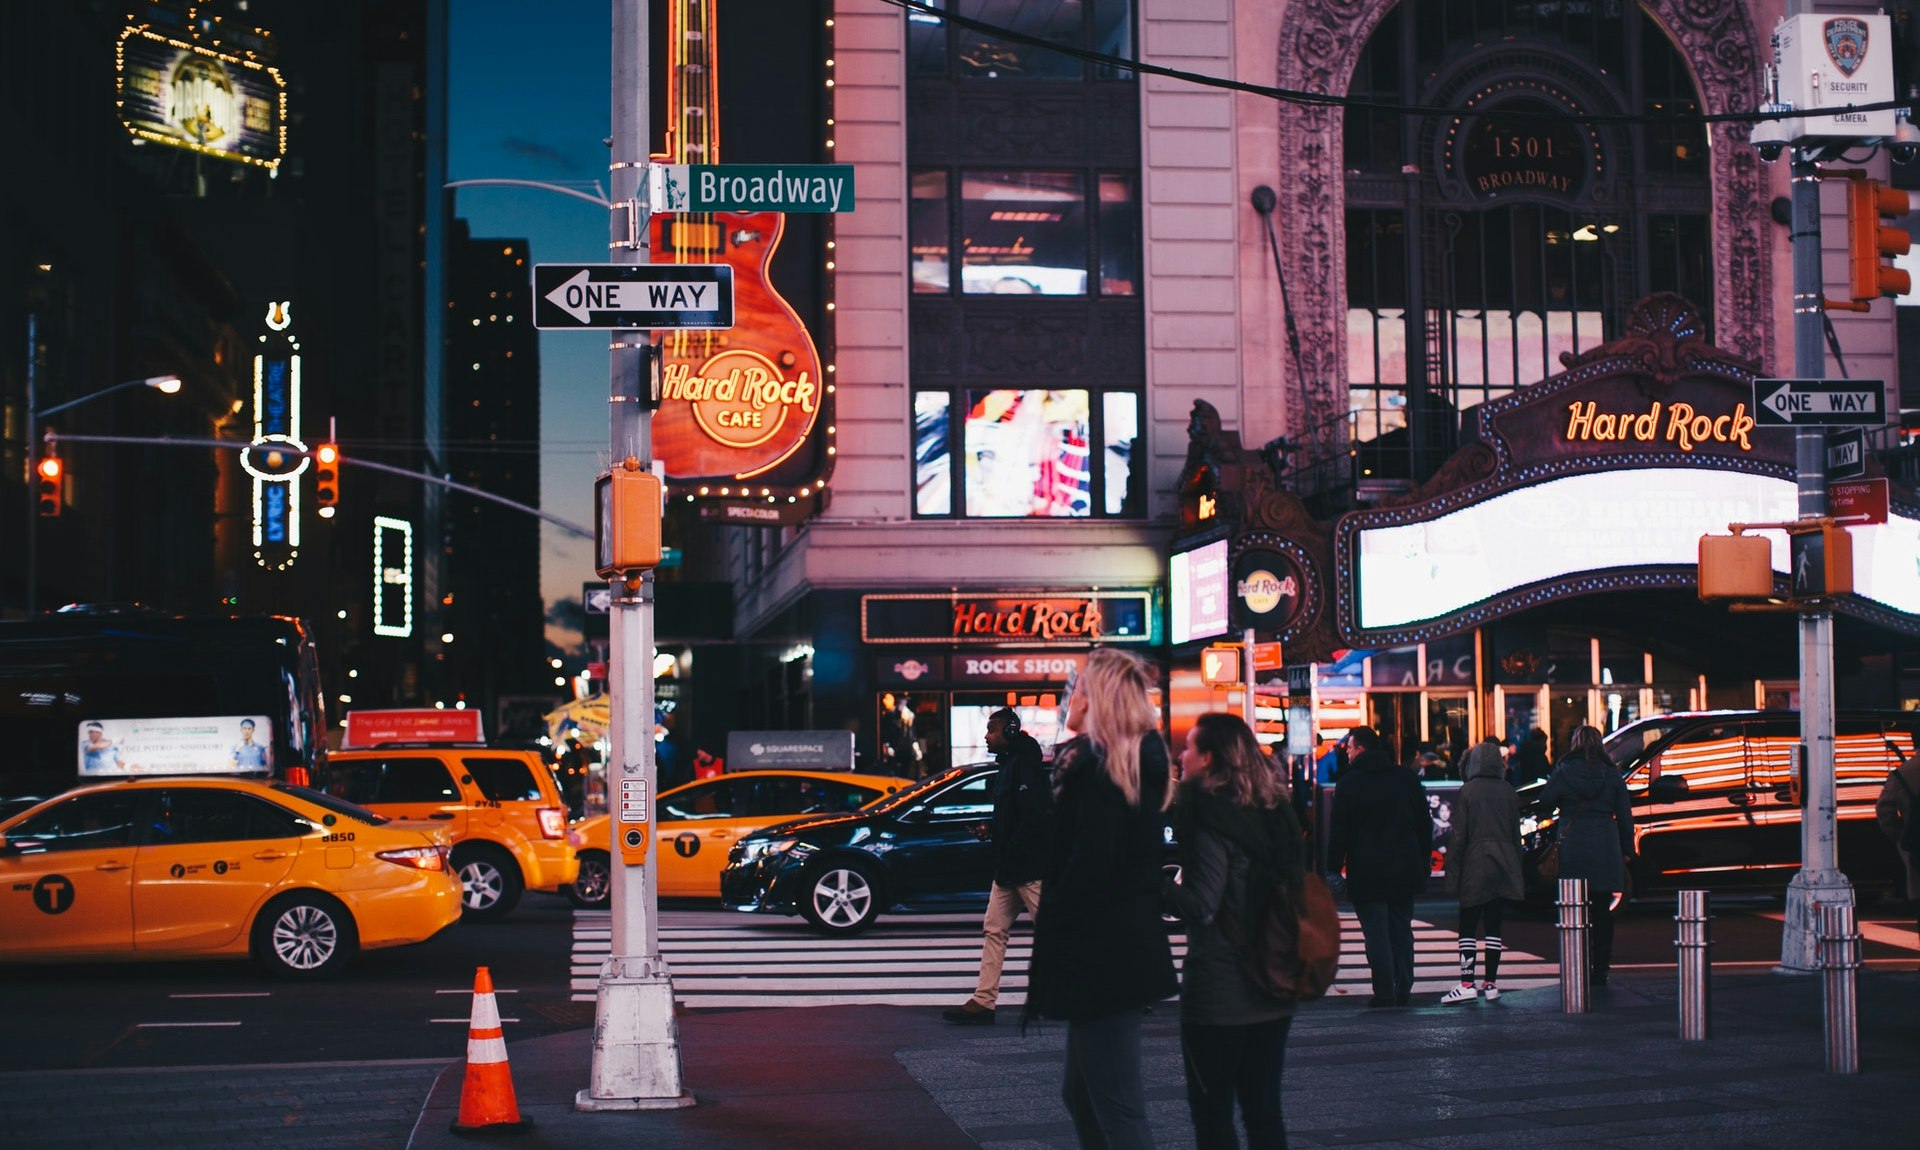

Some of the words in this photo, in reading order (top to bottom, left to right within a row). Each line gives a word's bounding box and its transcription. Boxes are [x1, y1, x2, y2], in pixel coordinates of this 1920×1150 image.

[1830, 82, 1868, 92] SECURITY
[1834, 114, 1868, 123] CAMERA
[1495, 137, 1552, 158] 1501
[700, 170, 844, 212] Broadway
[1478, 170, 1572, 192] BROADWAY
[566, 285, 621, 309] ONE
[648, 285, 707, 309] WAY
[662, 364, 740, 401] Hard
[741, 367, 815, 413] Rock
[1774, 394, 1811, 411] ONE
[1829, 394, 1868, 411] WAY
[717, 410, 762, 428] CAFE
[1566, 401, 1661, 441] Hard
[1666, 402, 1754, 451] Rock
[1833, 444, 1855, 466] WAY
[1836, 485, 1871, 496] STOPPING
[267, 485, 285, 542] LYRIC
[727, 506, 780, 520] SPECTACOLOR
[1262, 576, 1296, 597] Rock
[953, 602, 1027, 635] Hard
[1031, 602, 1102, 640] Rock
[966, 659, 1019, 675] ROCK
[1024, 658, 1076, 675] SHOP
[766, 744, 824, 754] SQUARESPACE
